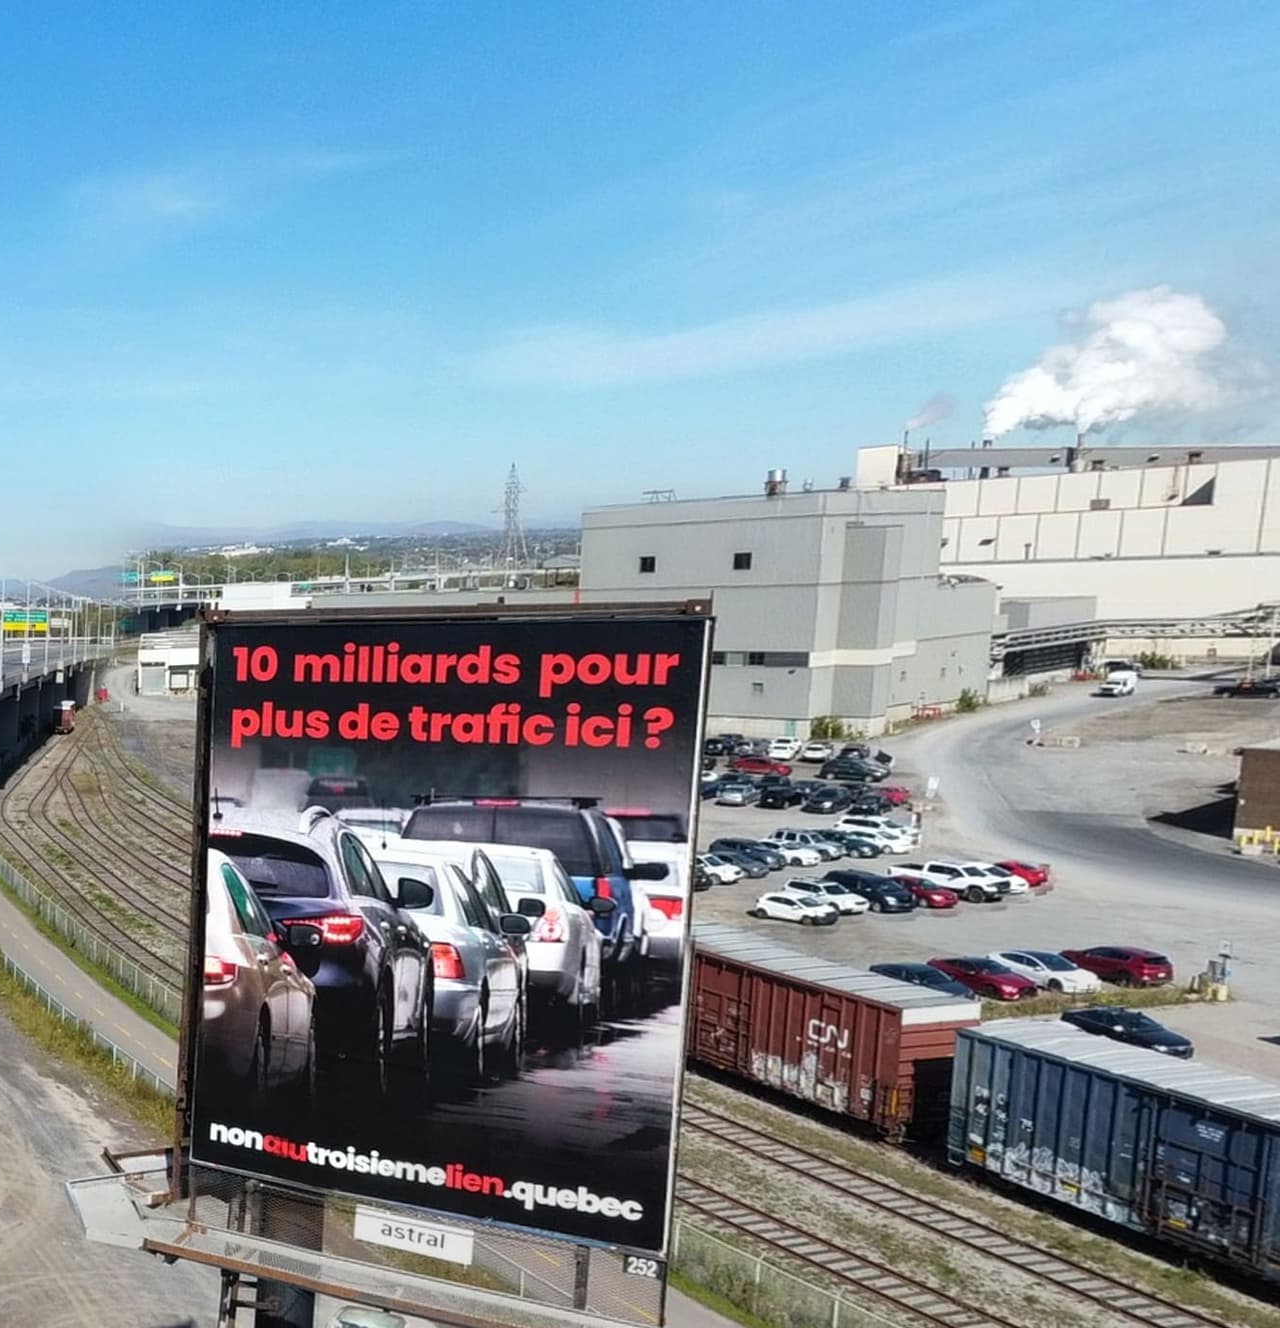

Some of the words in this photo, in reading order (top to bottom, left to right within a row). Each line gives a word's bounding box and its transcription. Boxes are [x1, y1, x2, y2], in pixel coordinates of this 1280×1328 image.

[233, 645, 278, 682] 10
[294, 642, 521, 685] milliards
[539, 652, 680, 698] pour
[231, 702, 329, 748] plus
[339, 703, 400, 741] de
[408, 704, 555, 746] trafic
[565, 703, 633, 748] ici
[644, 706, 675, 749] ?
[808, 1018, 849, 1049] CN
[209, 1122, 643, 1221] nonautroisiemelien.quebec
[380, 1221, 446, 1249] astral
[627, 1255, 658, 1277] 252
